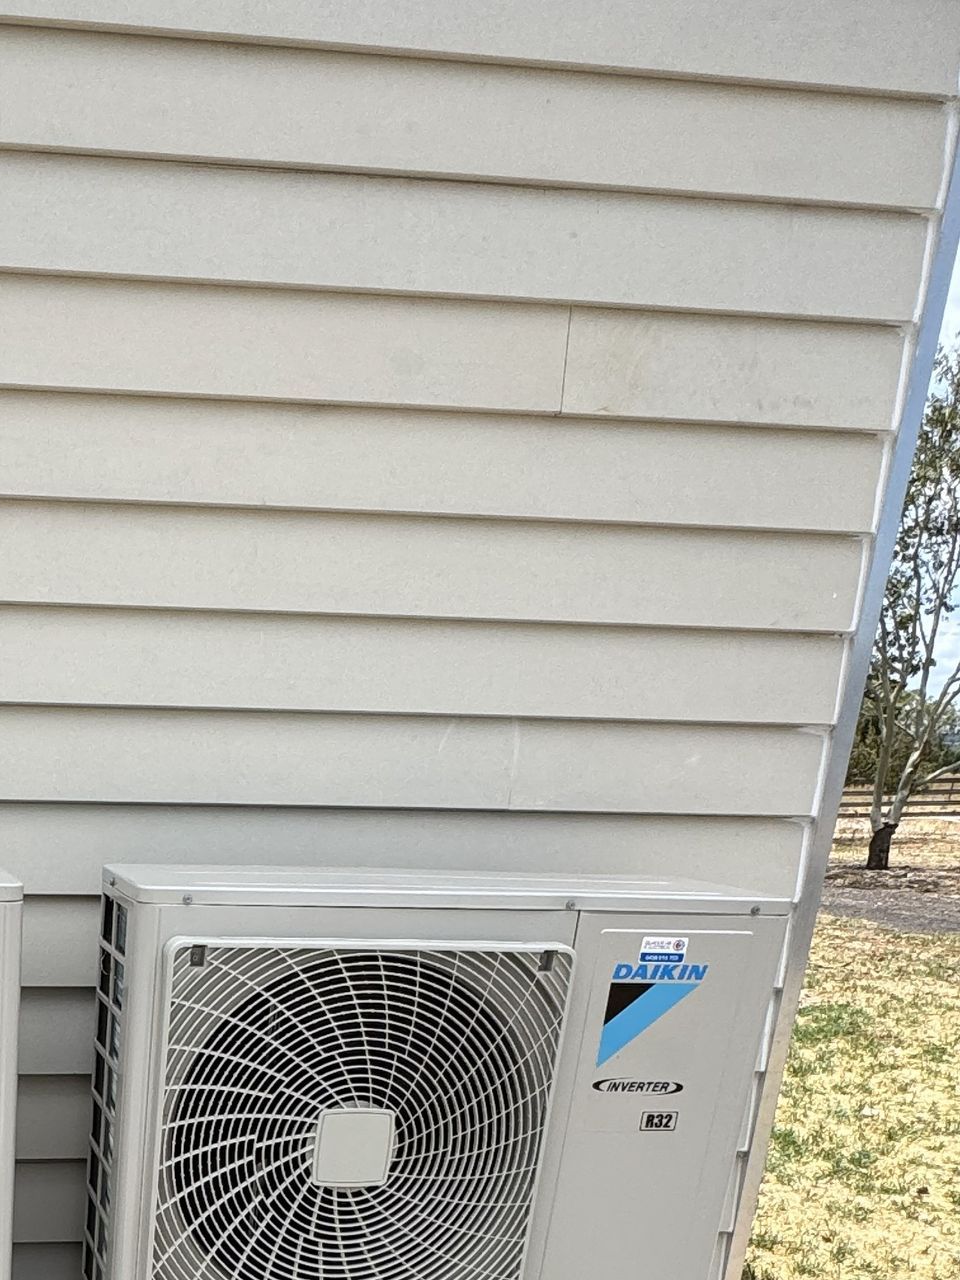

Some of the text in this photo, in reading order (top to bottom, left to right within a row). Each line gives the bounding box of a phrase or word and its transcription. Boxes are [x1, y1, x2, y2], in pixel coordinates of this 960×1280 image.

[612, 964, 709, 981] DAIKIN
[606, 1081, 670, 1093] INVERTER
[645, 1114, 673, 1129] R32
